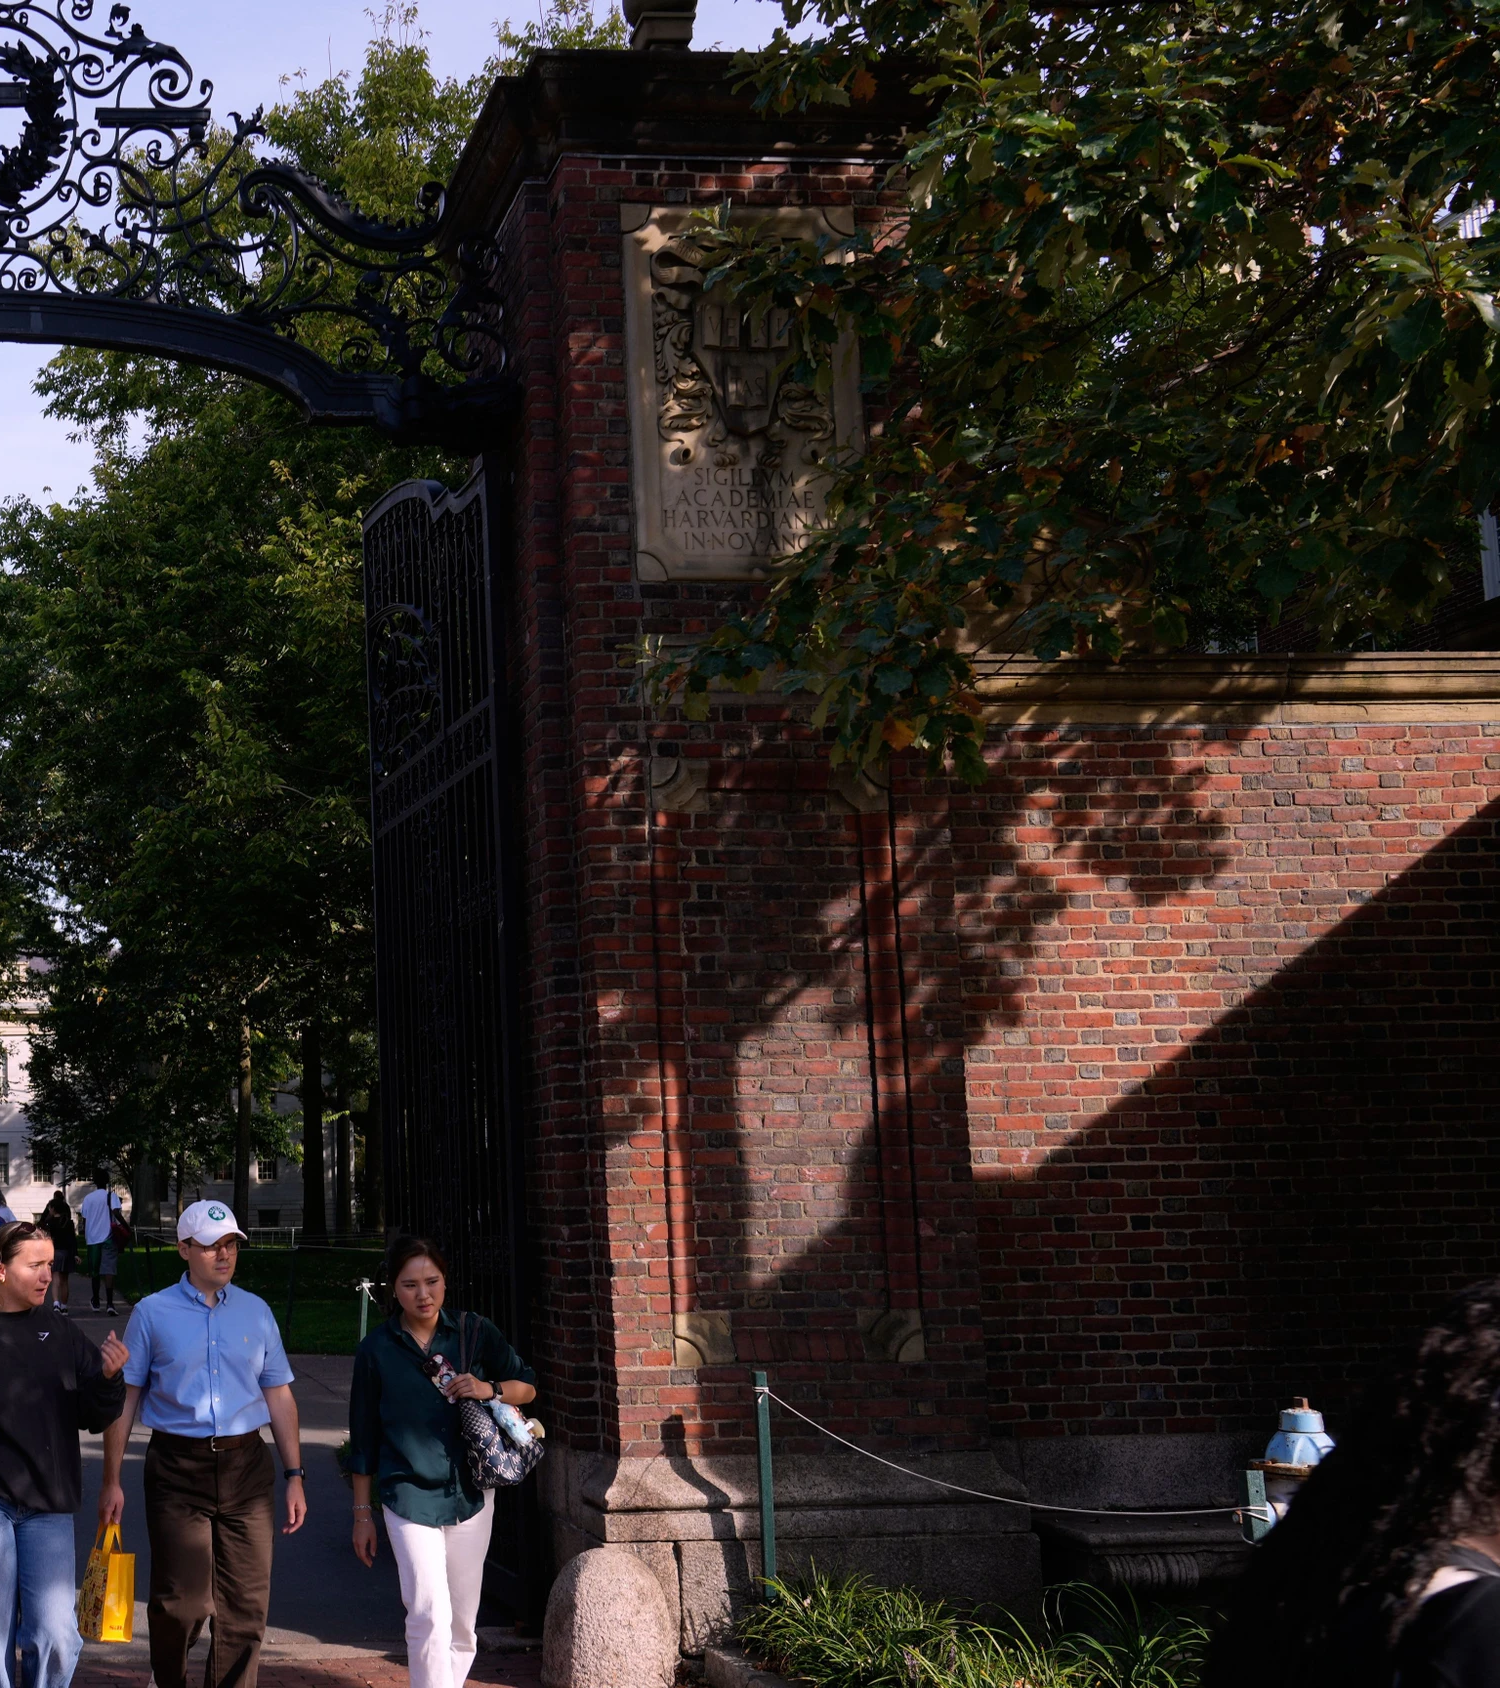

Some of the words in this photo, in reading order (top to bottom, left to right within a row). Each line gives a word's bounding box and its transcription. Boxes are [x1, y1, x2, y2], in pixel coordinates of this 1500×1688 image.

[730, 376, 764, 397] TAS
[694, 467, 796, 487] SIGILLVM
[676, 489, 815, 509] ACADEMIAE
